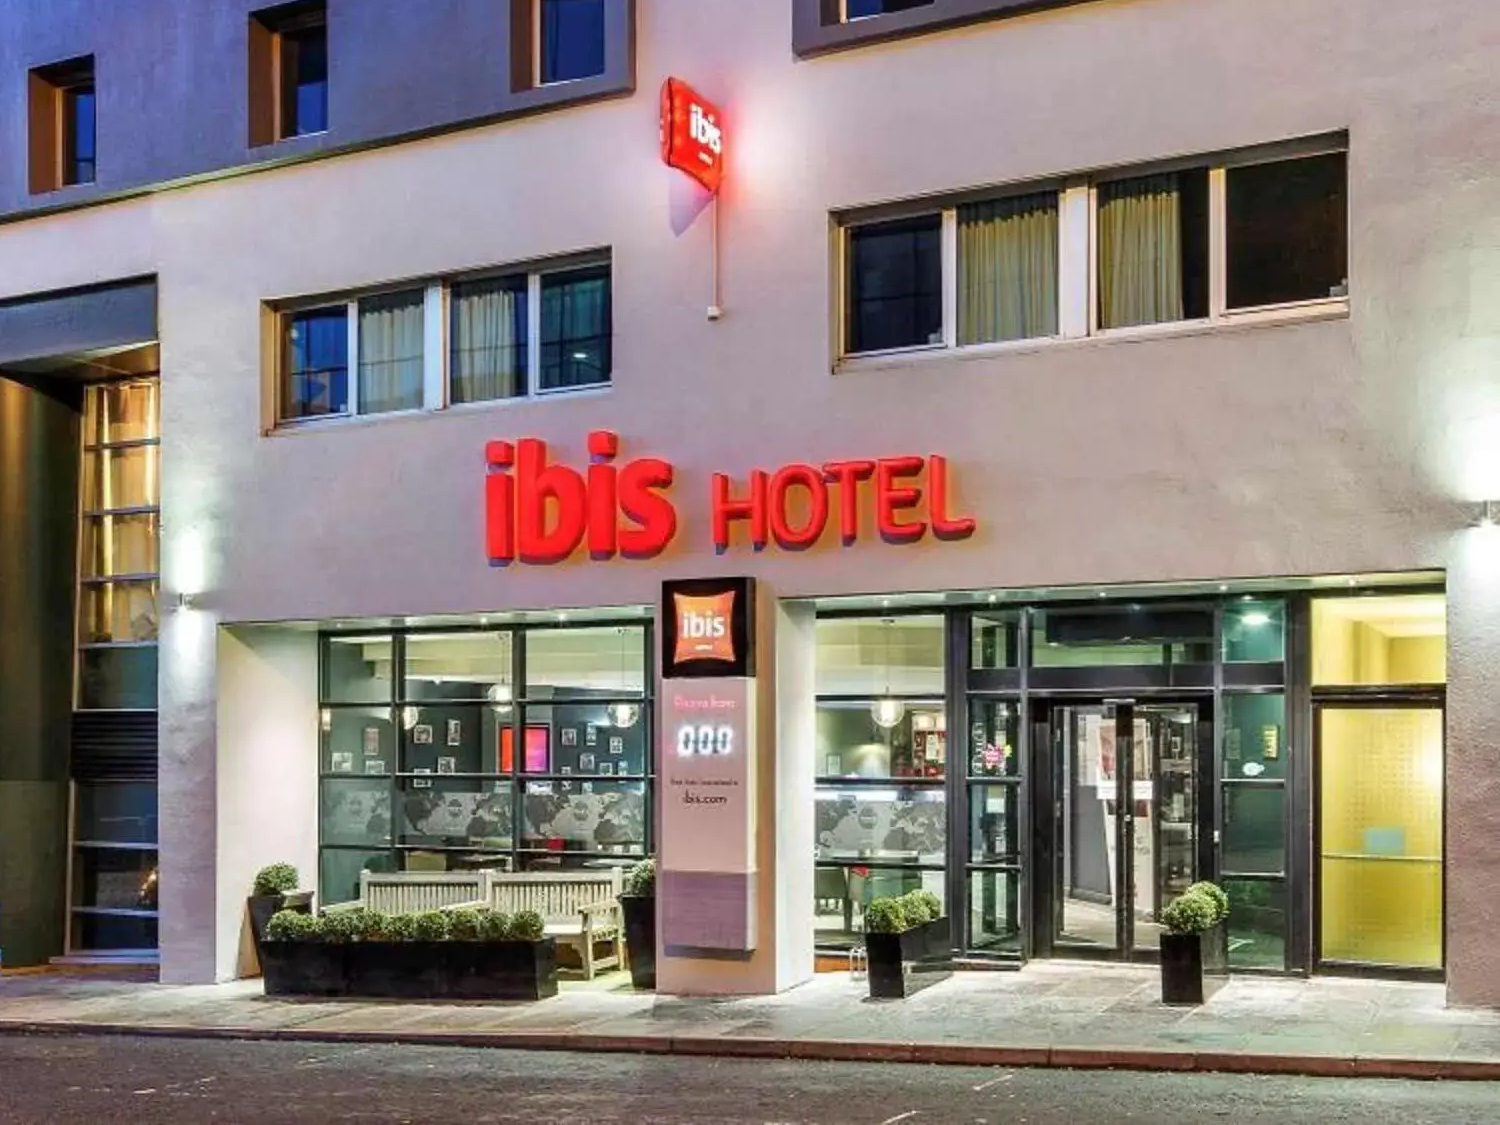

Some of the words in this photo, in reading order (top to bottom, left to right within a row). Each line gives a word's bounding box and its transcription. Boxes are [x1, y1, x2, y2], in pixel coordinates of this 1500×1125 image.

[690, 103, 722, 155] ibis
[485, 431, 677, 565] ibis
[712, 454, 977, 555] HOTEL
[683, 610, 726, 639] ibis
